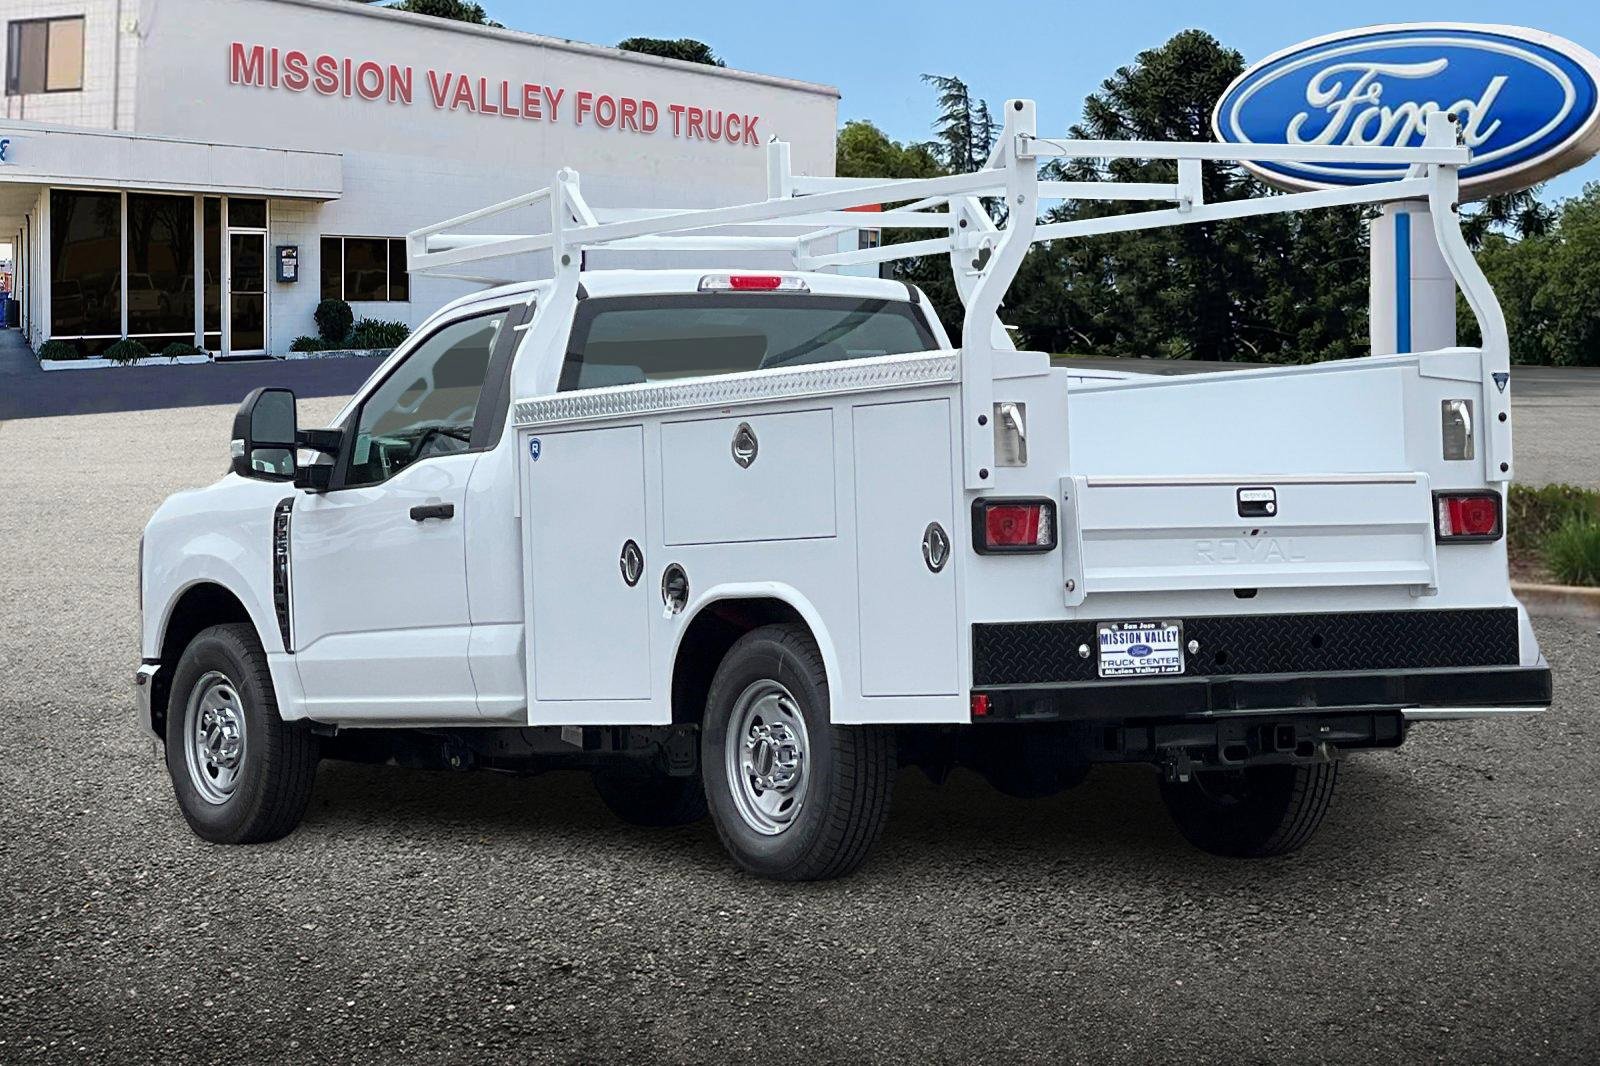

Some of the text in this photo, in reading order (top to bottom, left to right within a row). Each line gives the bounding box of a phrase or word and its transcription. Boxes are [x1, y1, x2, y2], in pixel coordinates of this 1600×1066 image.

[230, 41, 760, 146] MISSION VALLEY FORD TRUCK
[1286, 57, 1508, 147] Ford
[1194, 539, 1306, 563] ROYAL
[1100, 630, 1177, 645] MISSION VALLEY
[1101, 657, 1179, 667] TRUCK CENTER
